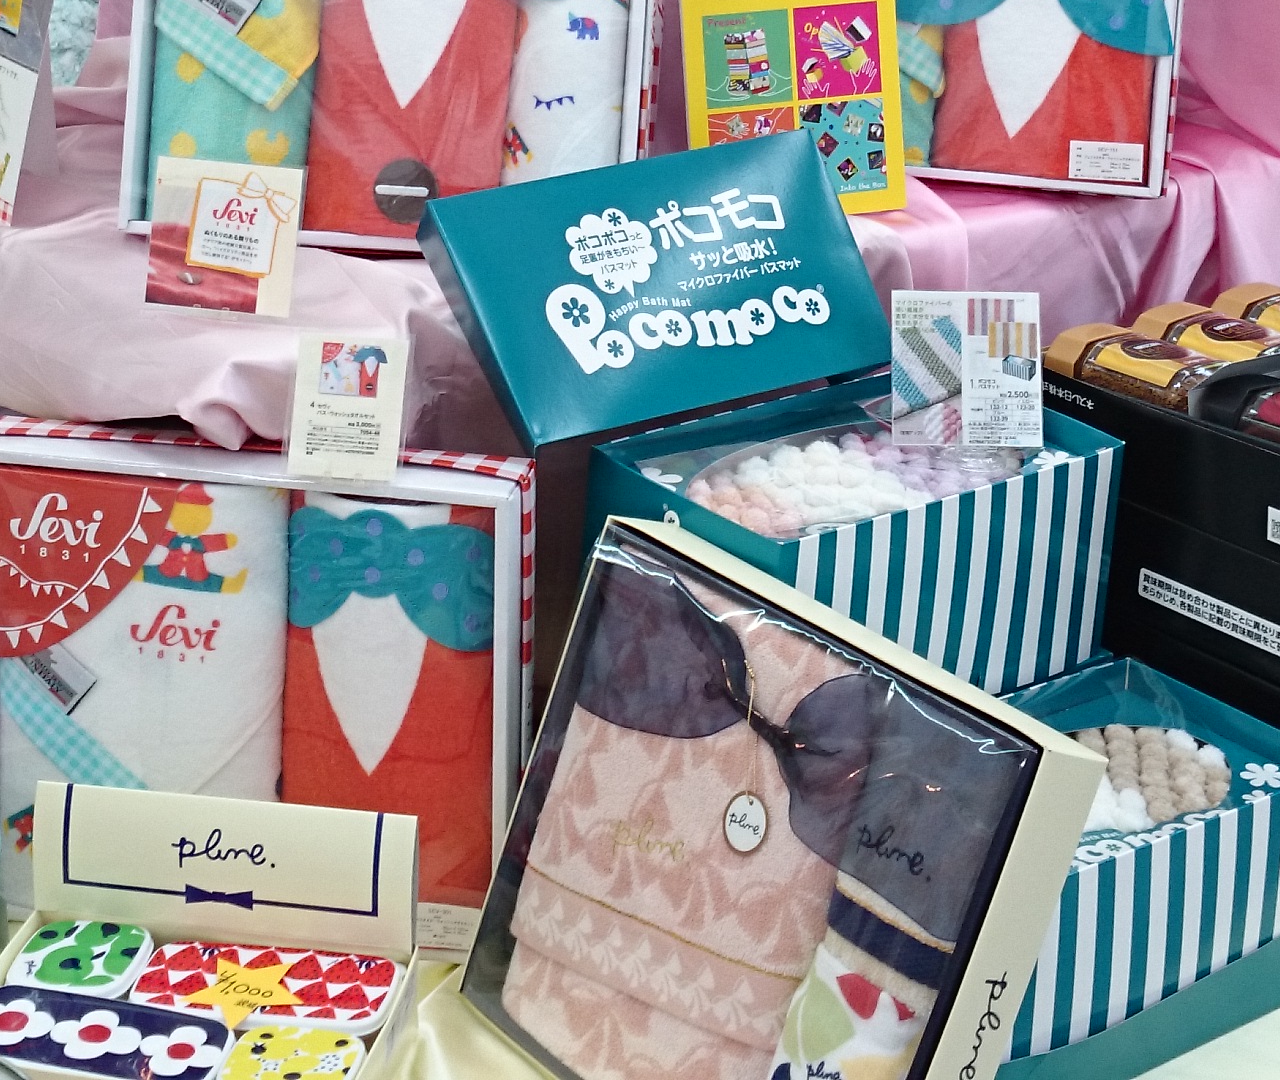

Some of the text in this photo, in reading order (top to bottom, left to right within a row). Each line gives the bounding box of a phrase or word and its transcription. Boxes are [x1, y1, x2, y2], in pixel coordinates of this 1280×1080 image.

[213, 198, 258, 225] Sevi
[648, 187, 786, 250] ポコモコ
[574, 228, 643, 251] ポコポコっと
[600, 258, 639, 274] バスマット
[676, 255, 802, 292] マイクロファイバー バスマット
[609, 295, 692, 321] Happy Bath Mat
[545, 283, 831, 375] Pocomoco
[9, 493, 103, 549] Sevi
[19, 544, 91, 562] 1831
[129, 603, 219, 652] Sevi
[137, 646, 206, 664] 1831
